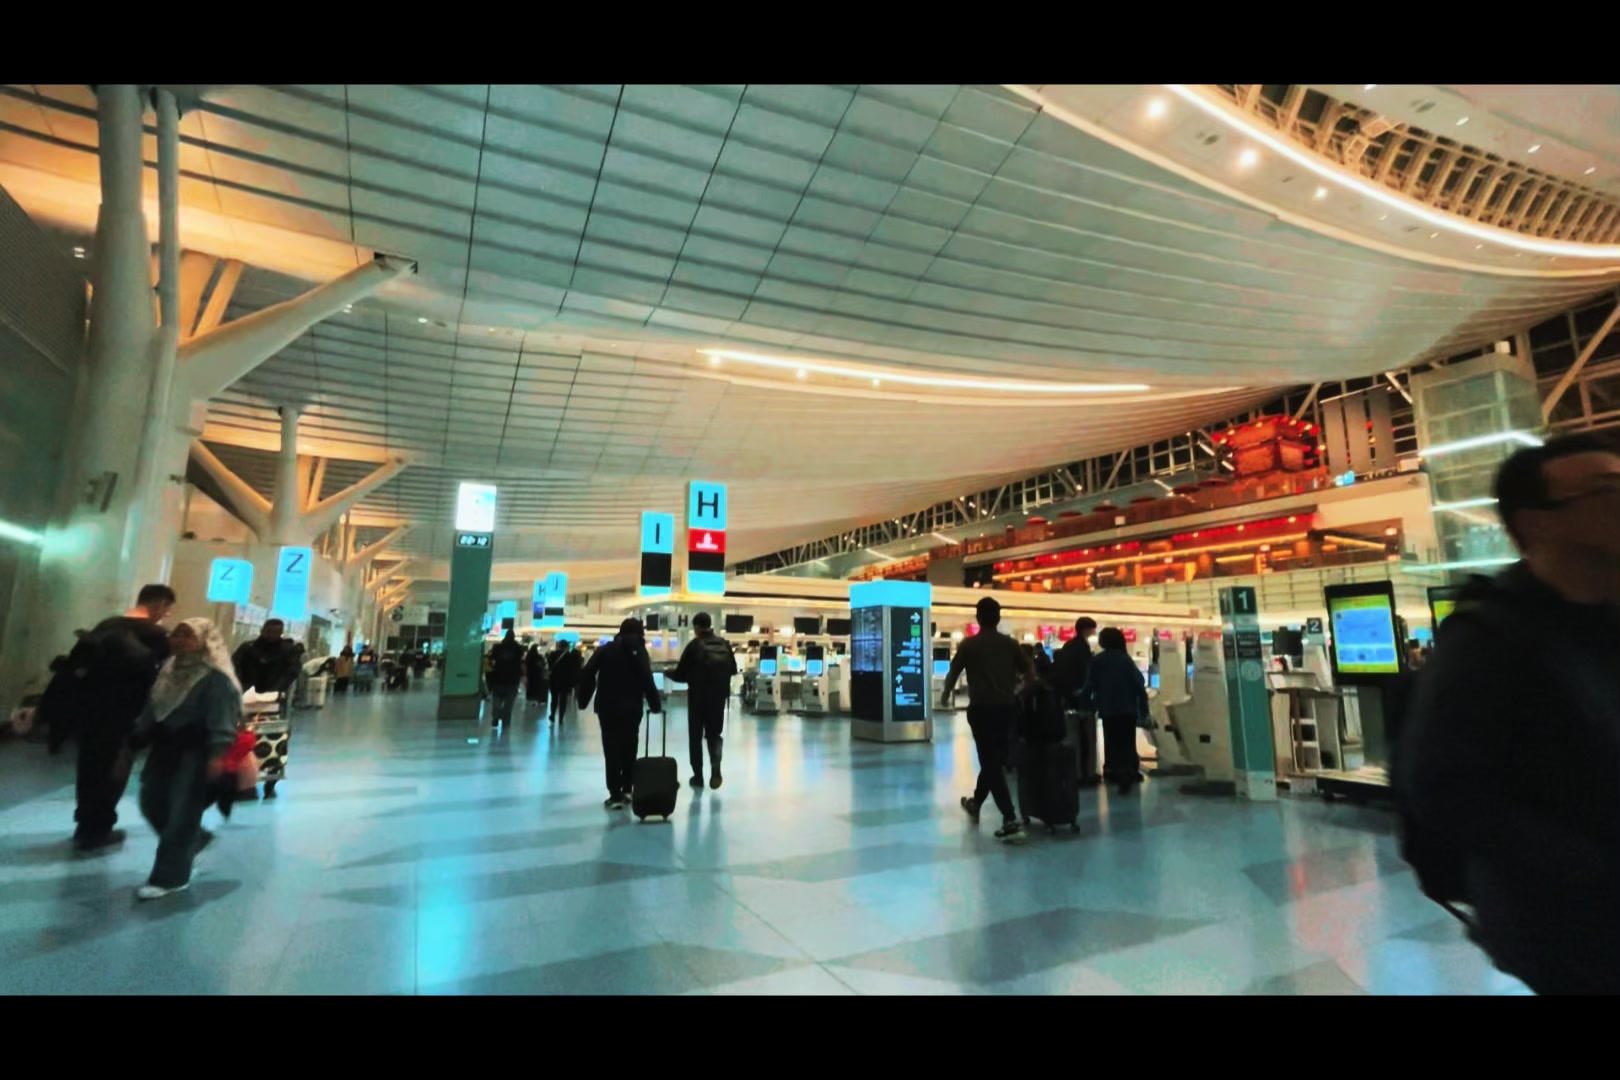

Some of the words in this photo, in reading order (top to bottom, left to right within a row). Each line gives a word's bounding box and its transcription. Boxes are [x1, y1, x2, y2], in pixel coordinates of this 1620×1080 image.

[698, 490, 718, 518] H
[655, 523, 660, 544] I
[220, 564, 235, 581] Z
[286, 552, 304, 574] Z
[1238, 591, 1248, 611] 1
[678, 614, 688, 627] H
[1310, 620, 1319, 632] 2
